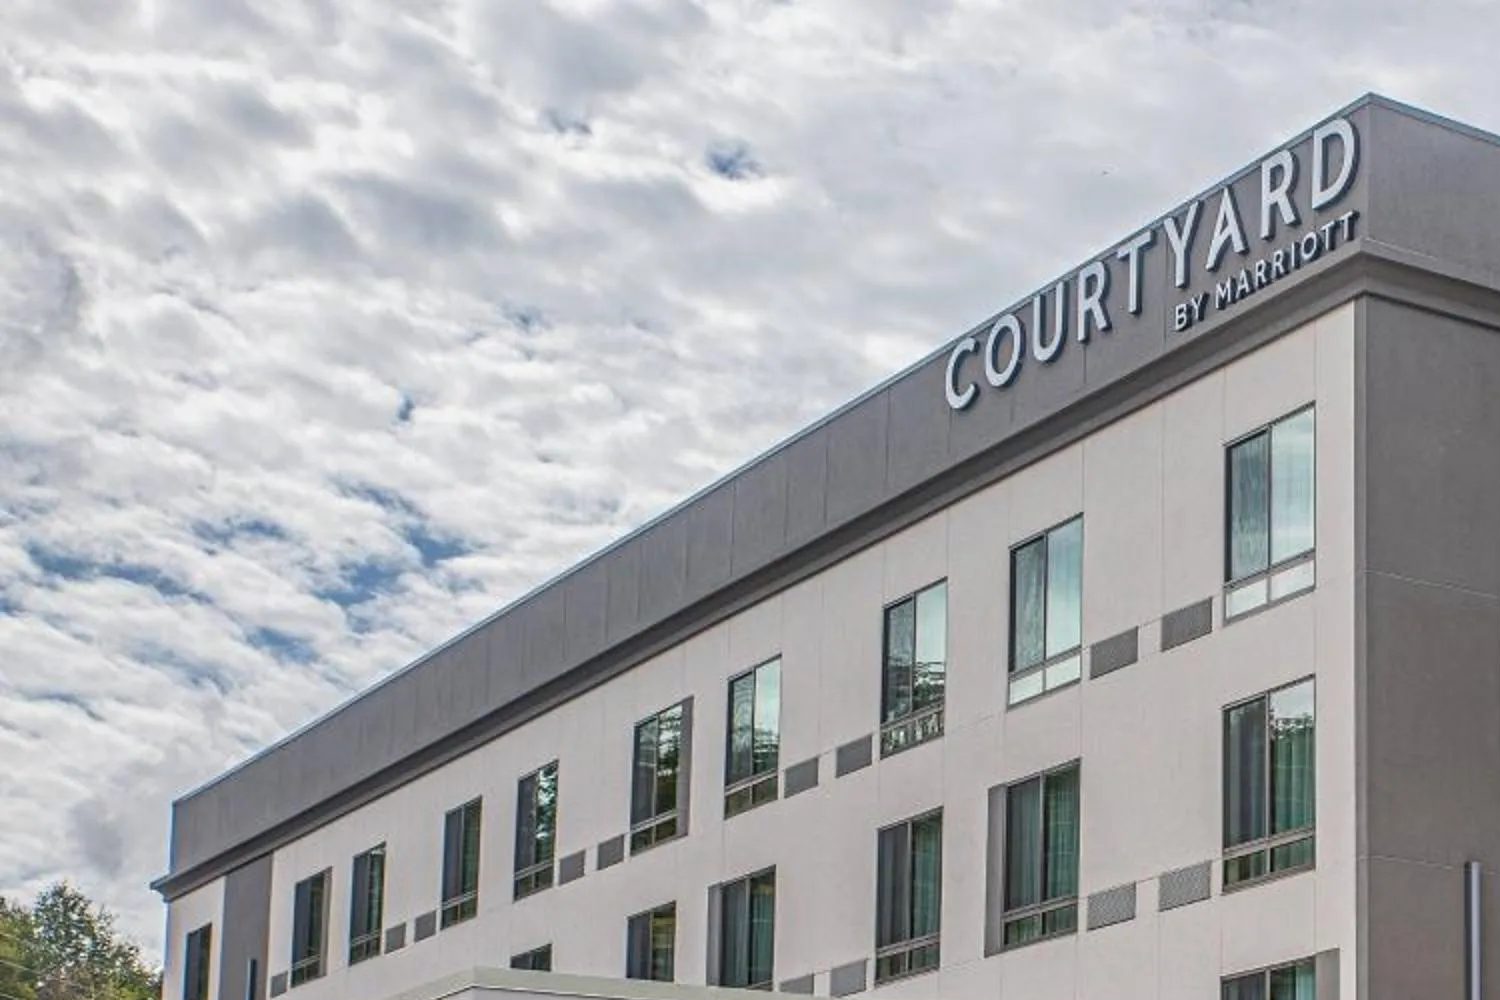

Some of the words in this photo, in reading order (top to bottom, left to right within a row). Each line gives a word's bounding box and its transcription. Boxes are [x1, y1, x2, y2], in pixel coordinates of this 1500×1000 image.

[945, 118, 1360, 410] COURTYARD
[1175, 293, 1209, 332] BY
[1215, 210, 1359, 310] MARRIOTT
